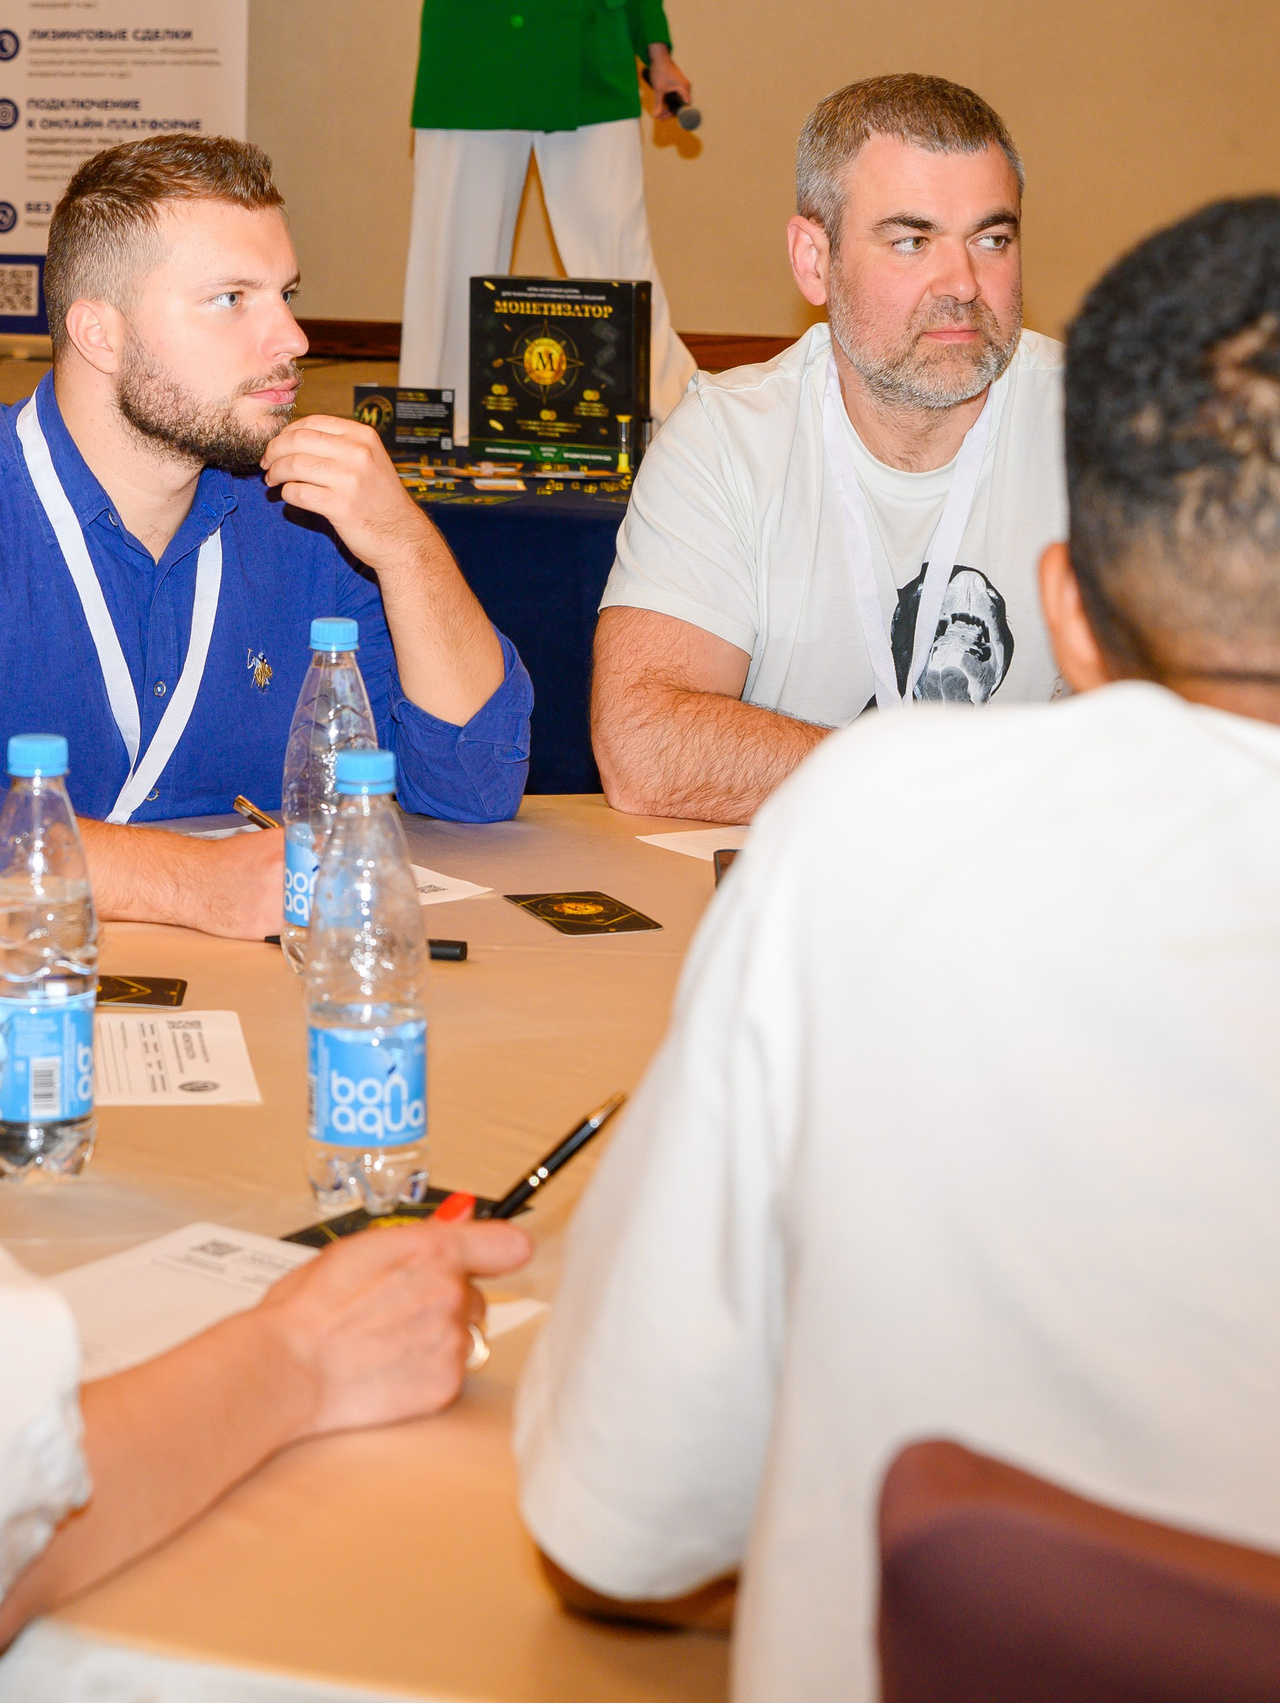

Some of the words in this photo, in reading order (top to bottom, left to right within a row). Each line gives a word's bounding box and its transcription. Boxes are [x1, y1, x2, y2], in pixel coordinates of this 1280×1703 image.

[29, 28, 128, 41] ЛИЗИНГОВЫЕ
[132, 28, 193, 41] СДЕЛКИ
[26, 99, 140, 111] ПОДКЛЮЧЕНИЕ
[26, 118, 36, 131] К
[25, 201, 52, 213] БЕЗ
[494, 300, 613, 318] МОНЕТИЗАТОР
[331, 1100, 425, 1139] aqua
